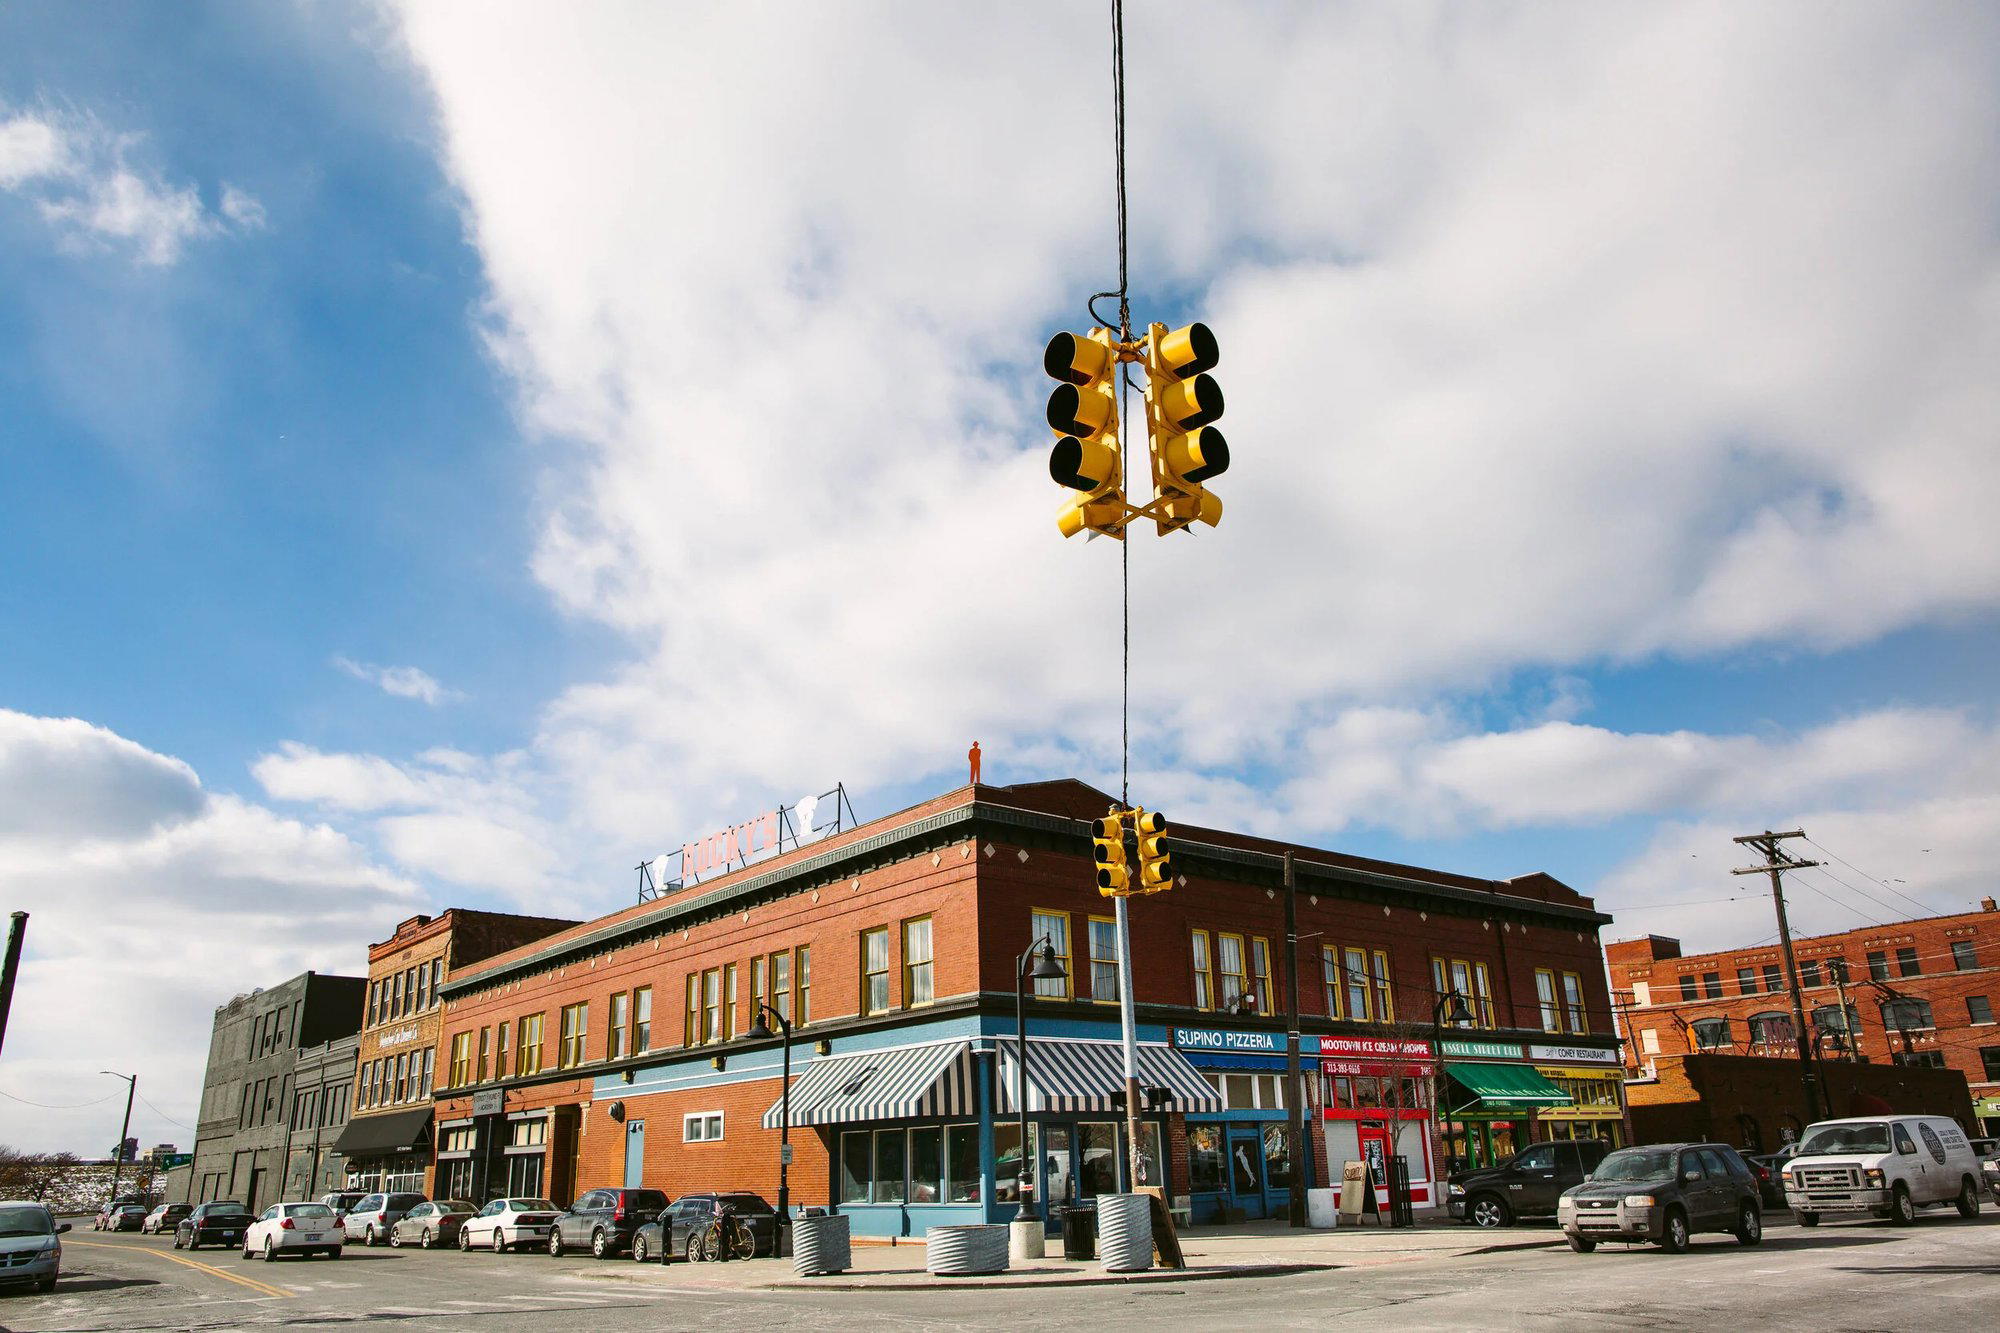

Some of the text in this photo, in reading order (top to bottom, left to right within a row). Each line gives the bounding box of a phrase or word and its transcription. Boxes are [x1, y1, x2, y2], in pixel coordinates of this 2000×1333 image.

[682, 809, 777, 881] ROCKY'S
[1178, 1030, 1274, 1048] SUPINO PIZZERIA
[1321, 1039, 1361, 1051] MOOTOWN
[1362, 1041, 1374, 1052] ICE
[1440, 1043, 1470, 1054] USSELL
[1558, 1048, 1575, 1058] CONEY
[1576, 1049, 1606, 1060] RESTAURANT
